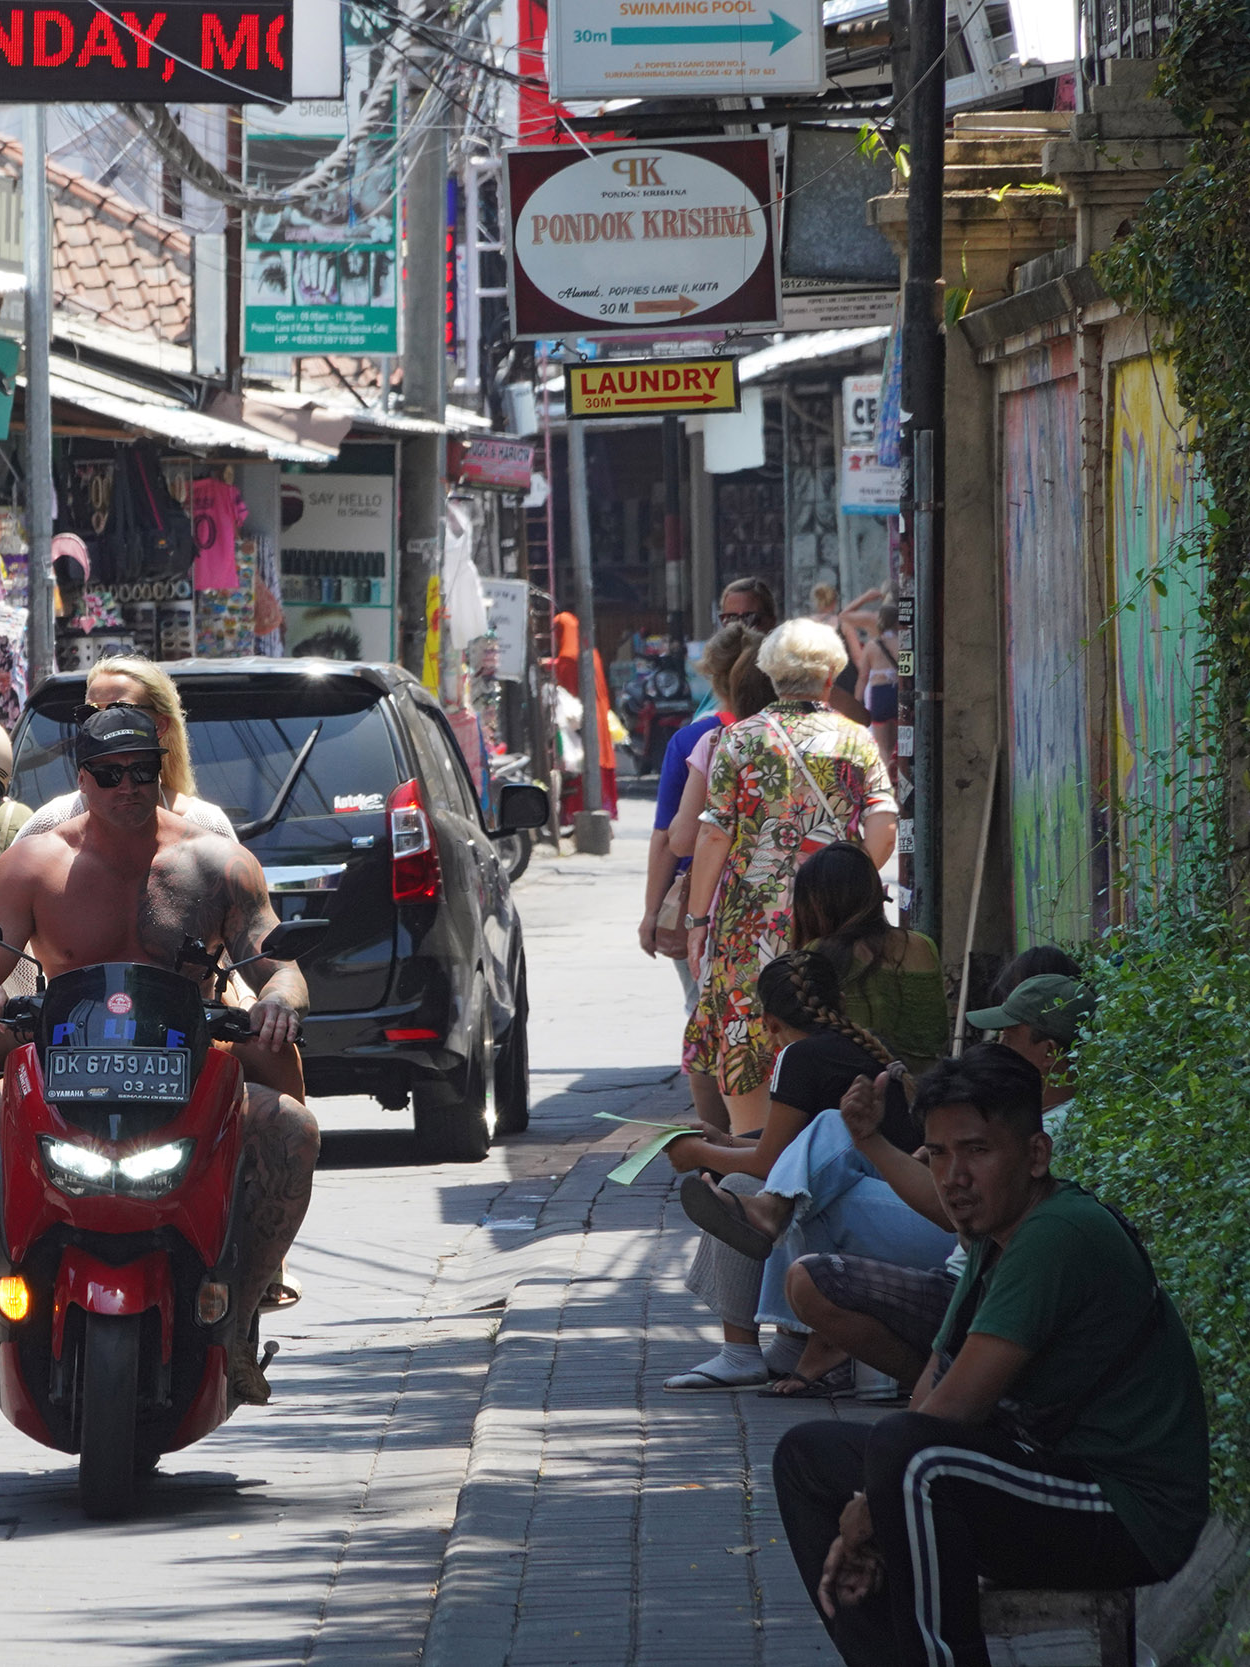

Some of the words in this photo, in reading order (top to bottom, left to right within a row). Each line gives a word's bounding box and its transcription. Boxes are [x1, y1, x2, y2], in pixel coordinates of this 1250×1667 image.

[619, 1, 709, 16] SWIMMING
[712, 0, 757, 14] POOL
[573, 30, 607, 43] 30m
[531, 211, 635, 246] PONDOK
[608, 286, 649, 296] POPPIES
[652, 285, 678, 294] LANE
[600, 304, 618, 315] 30
[580, 367, 722, 396] LAUNDRY
[585, 397, 612, 409] 30M
[308, 492, 335, 506] SAY
[338, 494, 382, 508] HELLO
[54, 1055, 81, 1075] DK
[86, 1055, 139, 1075] 6759
[143, 1056, 182, 1076] ADJ
